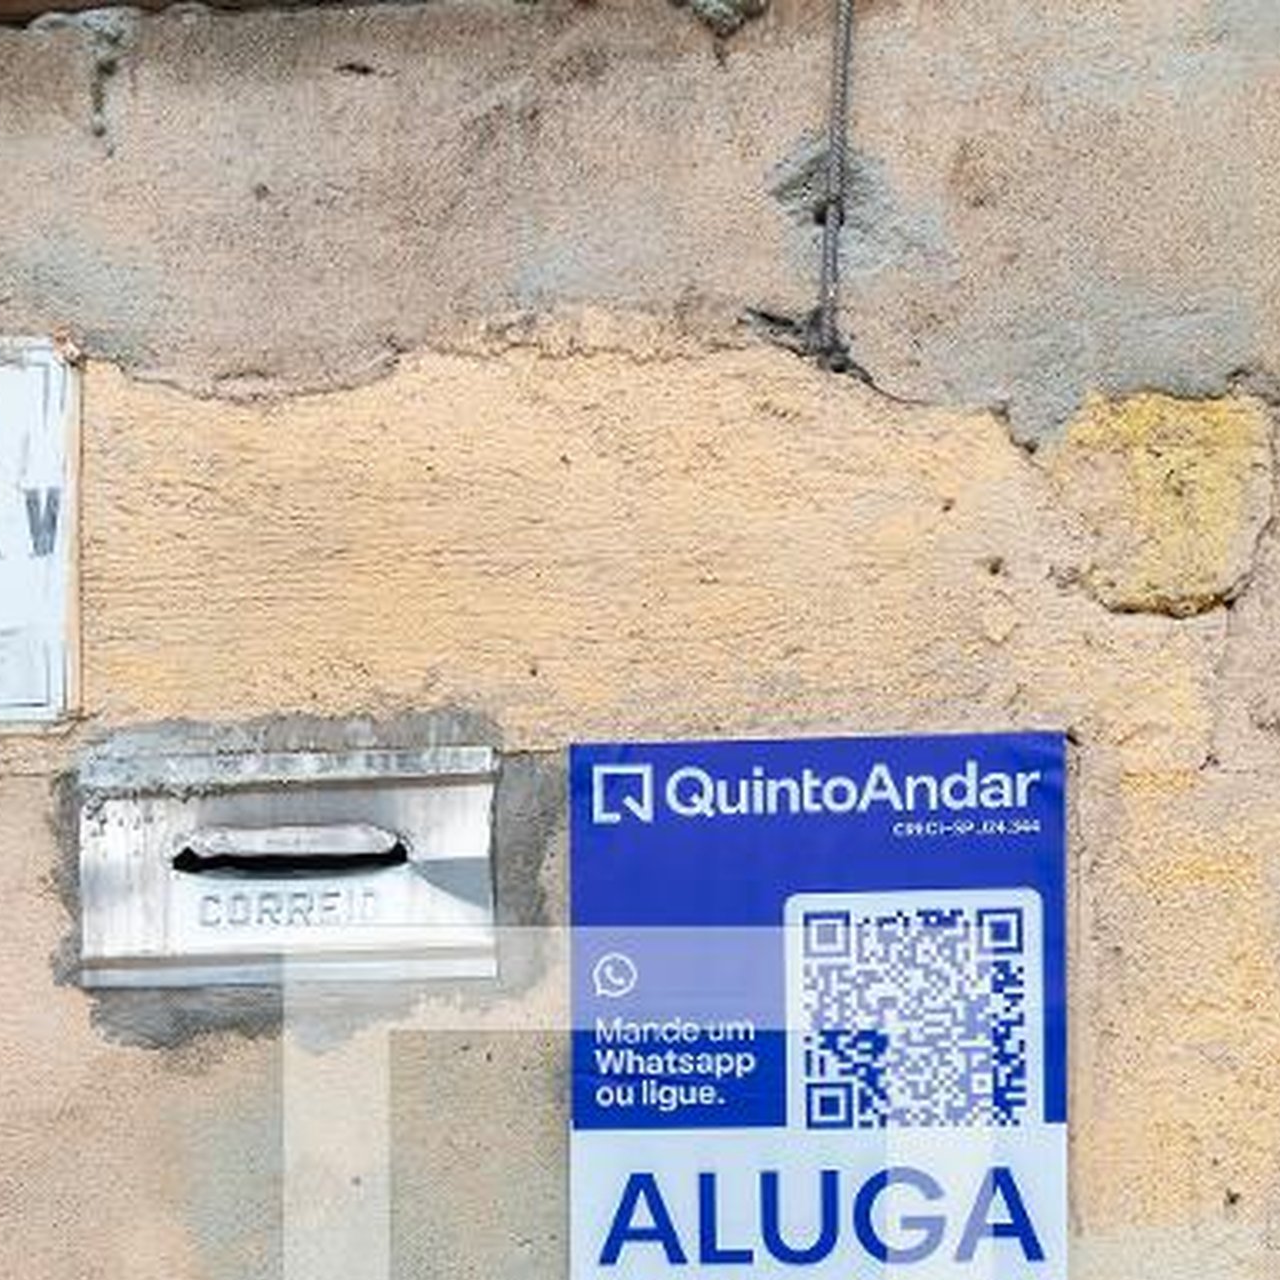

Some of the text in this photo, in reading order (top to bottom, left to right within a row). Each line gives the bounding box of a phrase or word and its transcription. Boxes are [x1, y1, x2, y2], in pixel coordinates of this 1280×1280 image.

[664, 760, 1041, 817] QuintoAndar
[594, 1016, 756, 1045] Mande um
[593, 1048, 757, 1079] Whatsapp
[595, 1079, 727, 1112] ou ligue.
[598, 1166, 1046, 1266] ALUGA
